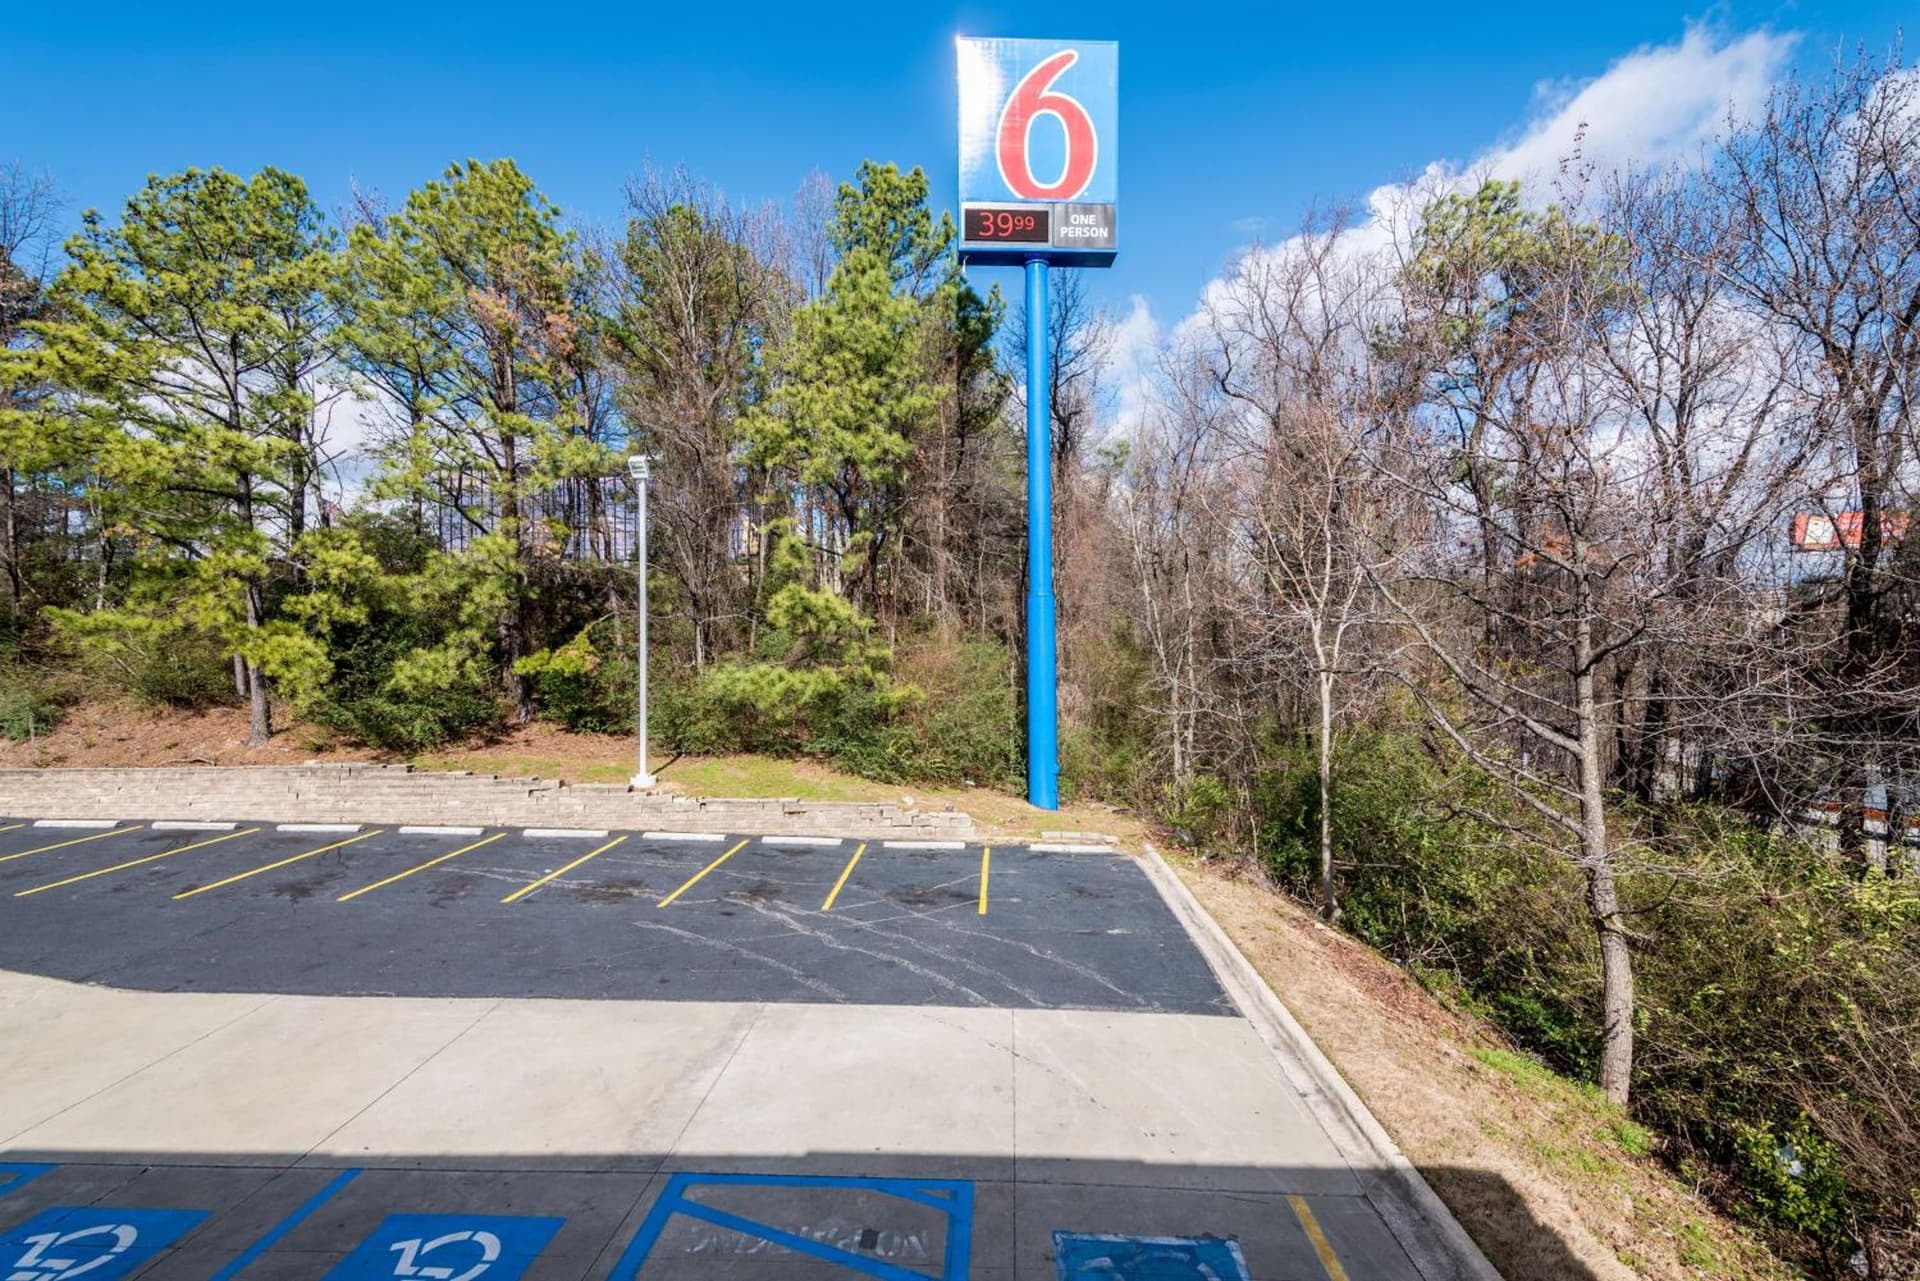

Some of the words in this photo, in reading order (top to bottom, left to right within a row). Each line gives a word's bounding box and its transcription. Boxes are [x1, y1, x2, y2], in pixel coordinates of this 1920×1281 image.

[996, 49, 1098, 201] 6
[1070, 214, 1097, 225] ONE
[1060, 227, 1109, 238] PERSON
